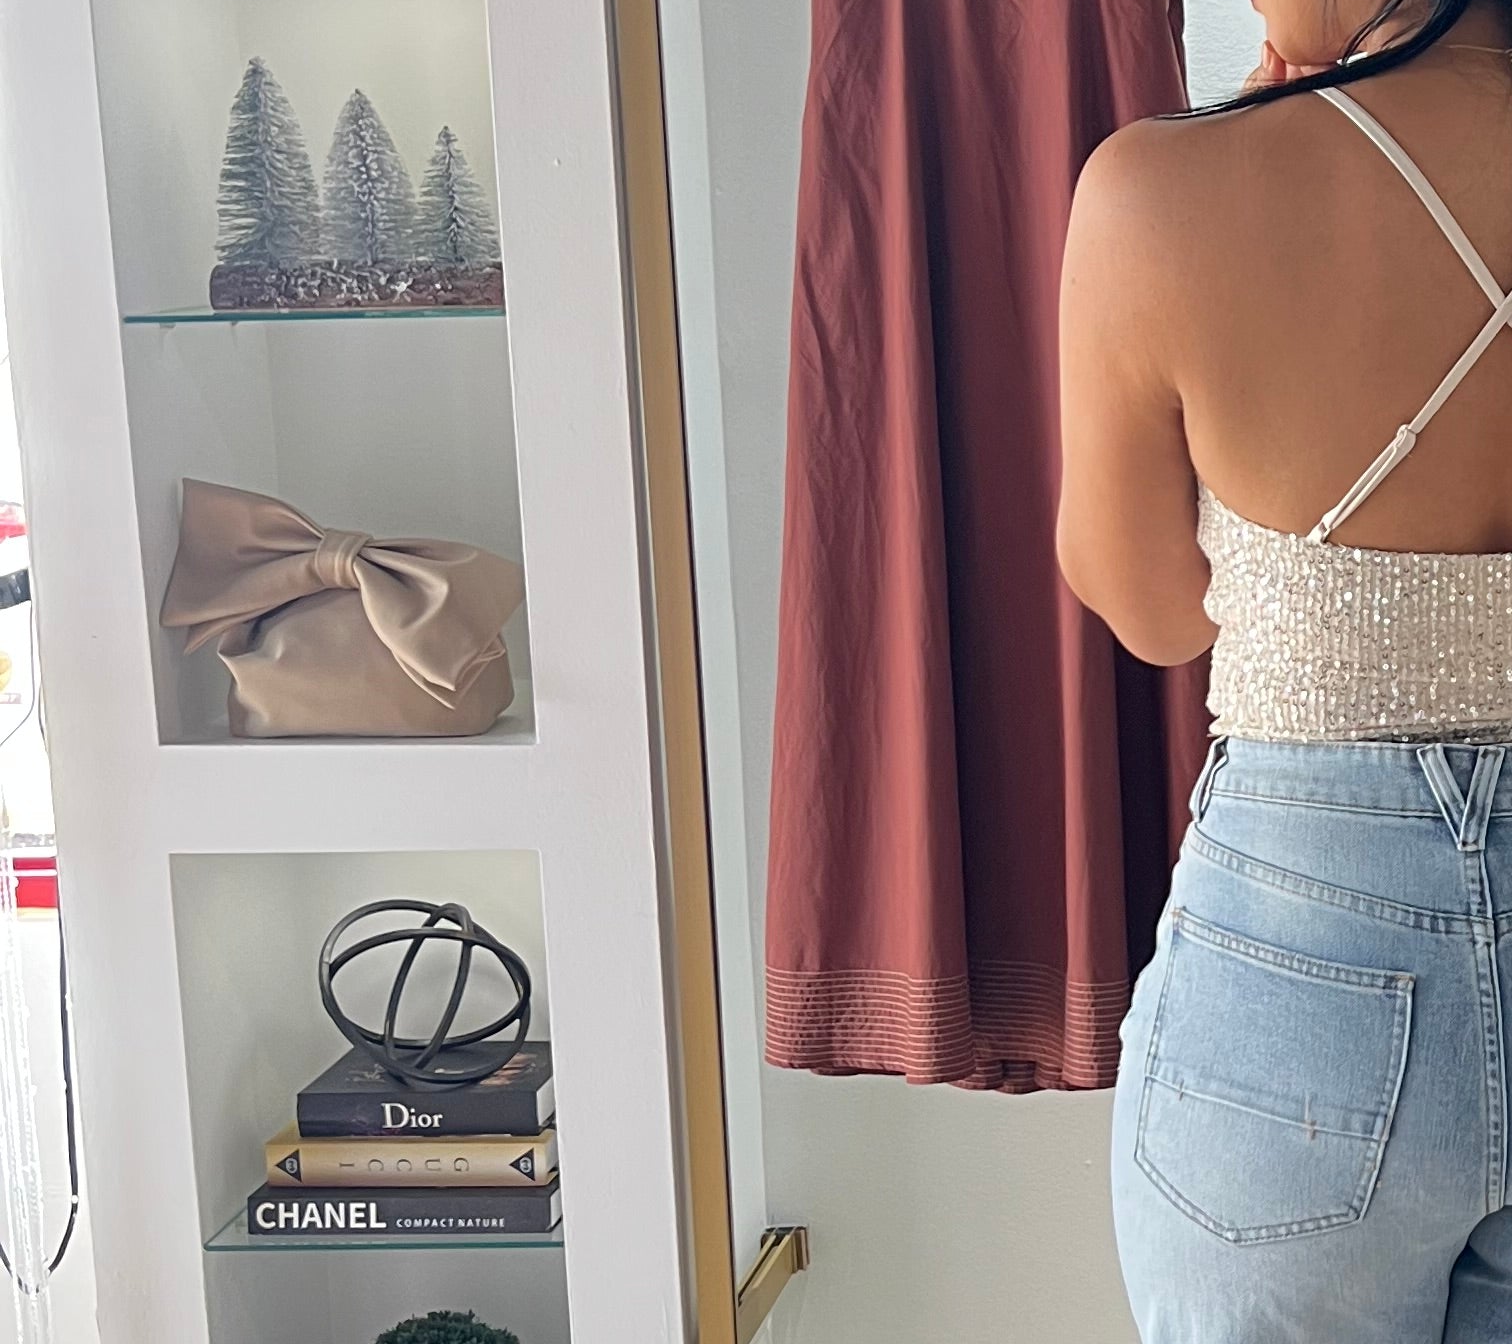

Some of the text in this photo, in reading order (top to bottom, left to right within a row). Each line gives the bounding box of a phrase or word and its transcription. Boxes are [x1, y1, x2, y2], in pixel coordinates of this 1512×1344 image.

[381, 1102, 443, 1129] Dior
[339, 1157, 470, 1172] GUCCI
[256, 1202, 505, 1229] CHANEL COMPACT NATURE
